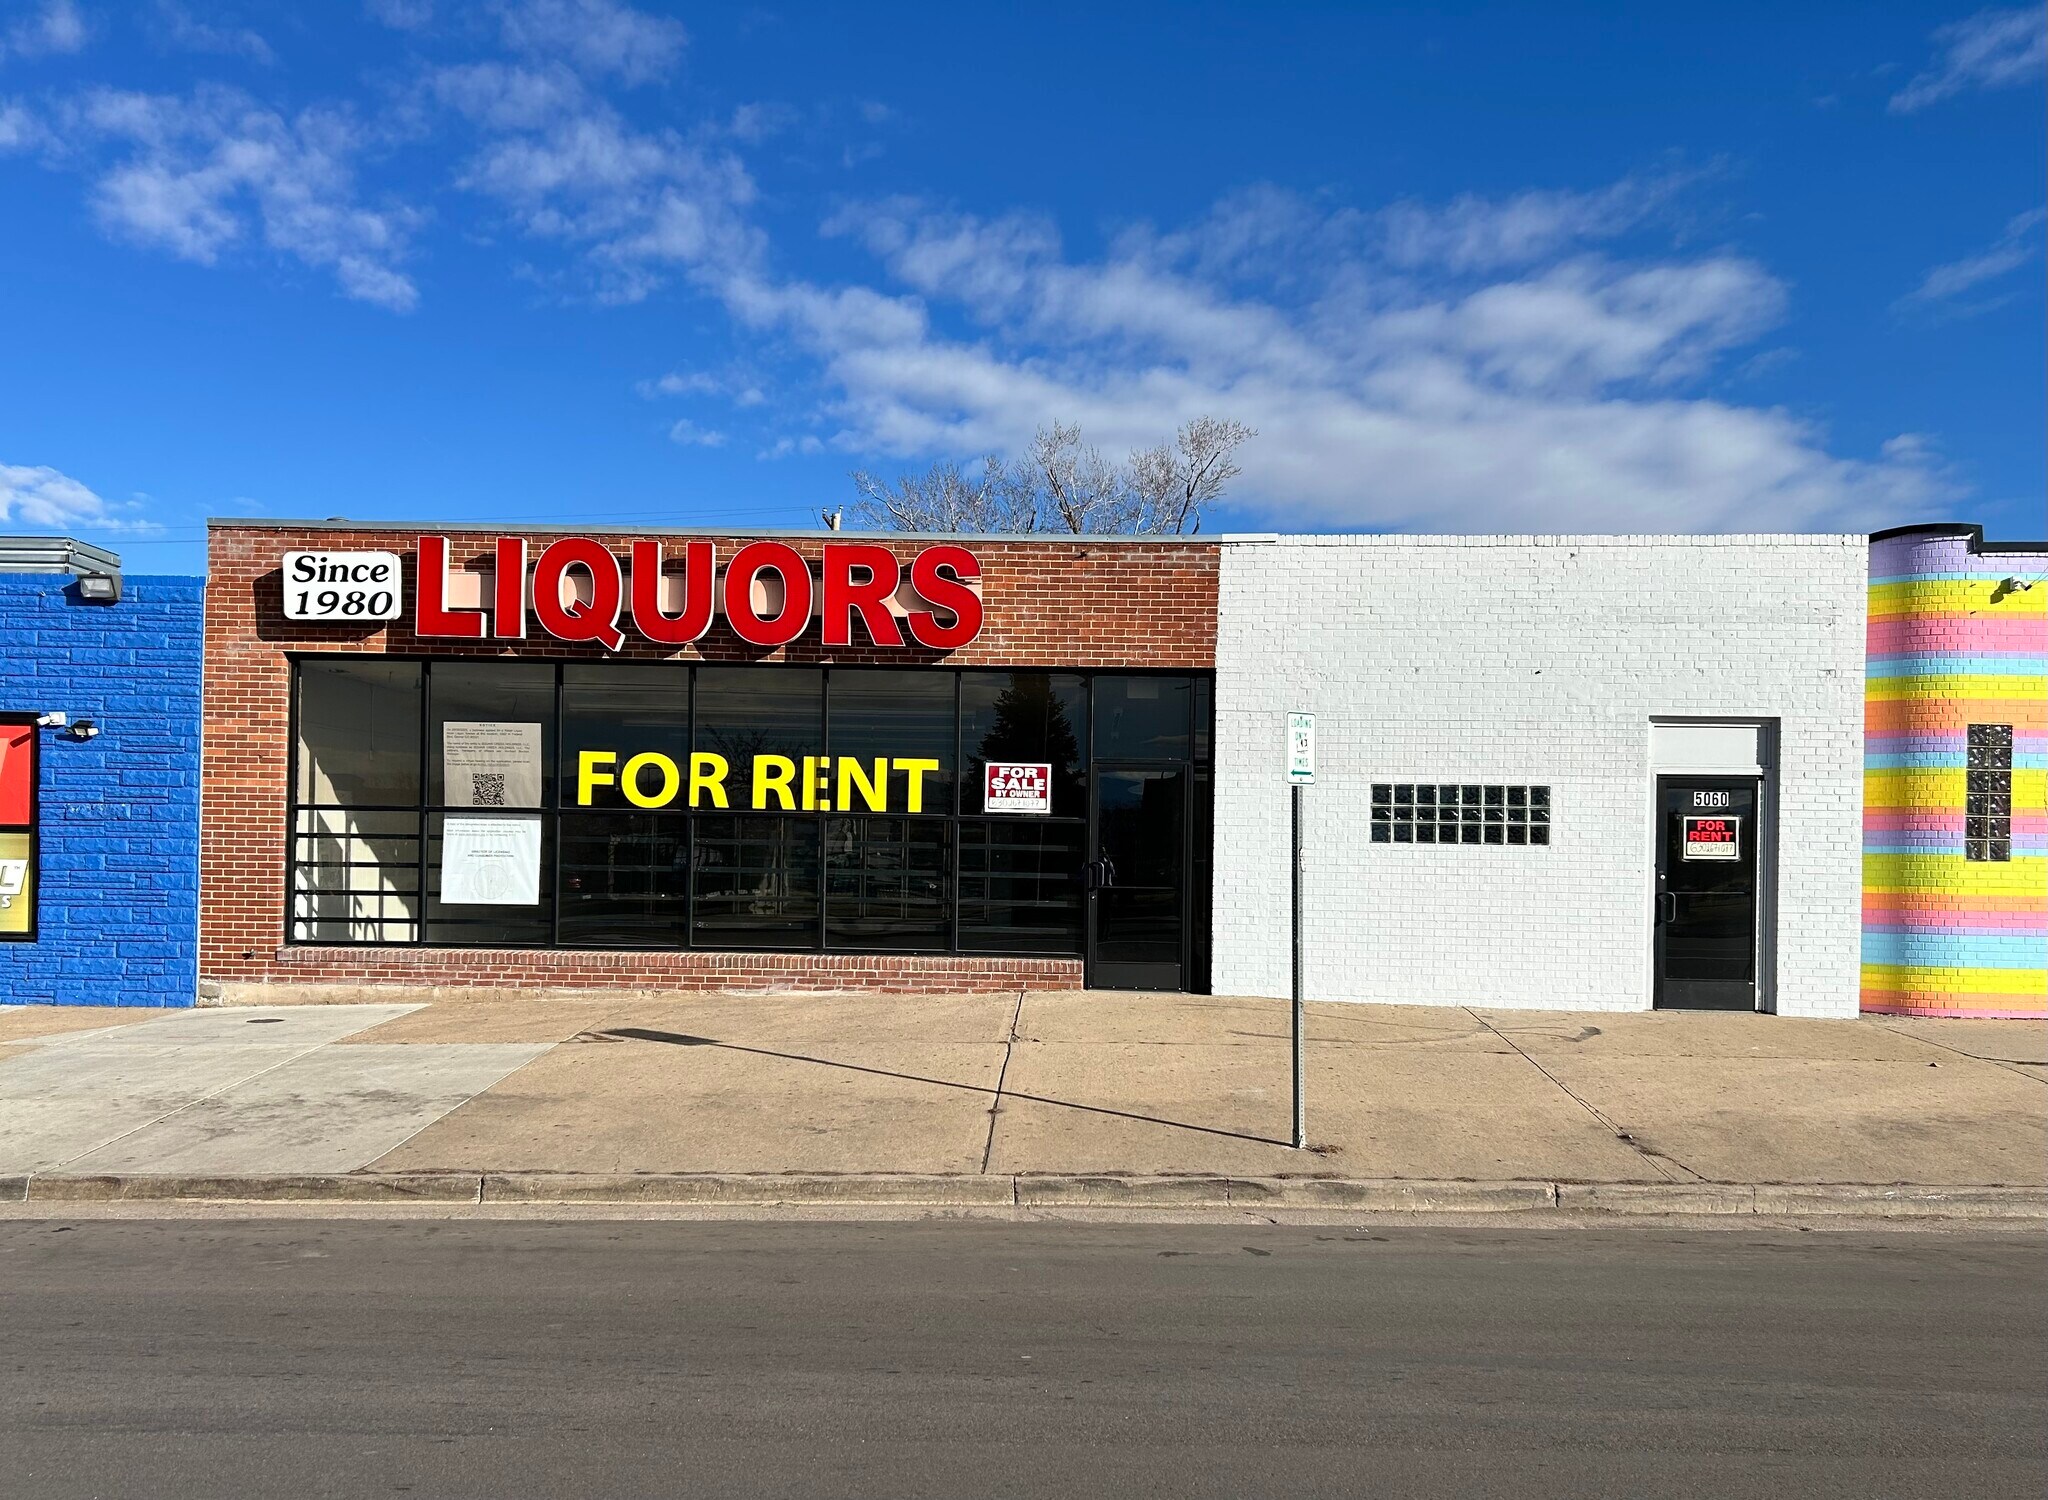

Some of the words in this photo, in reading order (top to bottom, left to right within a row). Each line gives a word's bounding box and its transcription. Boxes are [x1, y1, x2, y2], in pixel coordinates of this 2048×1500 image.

[291, 555, 391, 586] Since
[416, 536, 983, 651] LIQUORS
[293, 590, 394, 617] 1980
[1291, 718, 1312, 728] LOADING
[998, 767, 1038, 779] FOR
[577, 750, 730, 809] FOR
[752, 754, 940, 814] RENT
[991, 778, 1045, 791] SALE
[996, 790, 1007, 798] BY
[1009, 790, 1040, 798] OWNER
[1695, 792, 1728, 806] 5060
[1697, 820, 1726, 831] FOR
[1689, 831, 1734, 842] RENT
